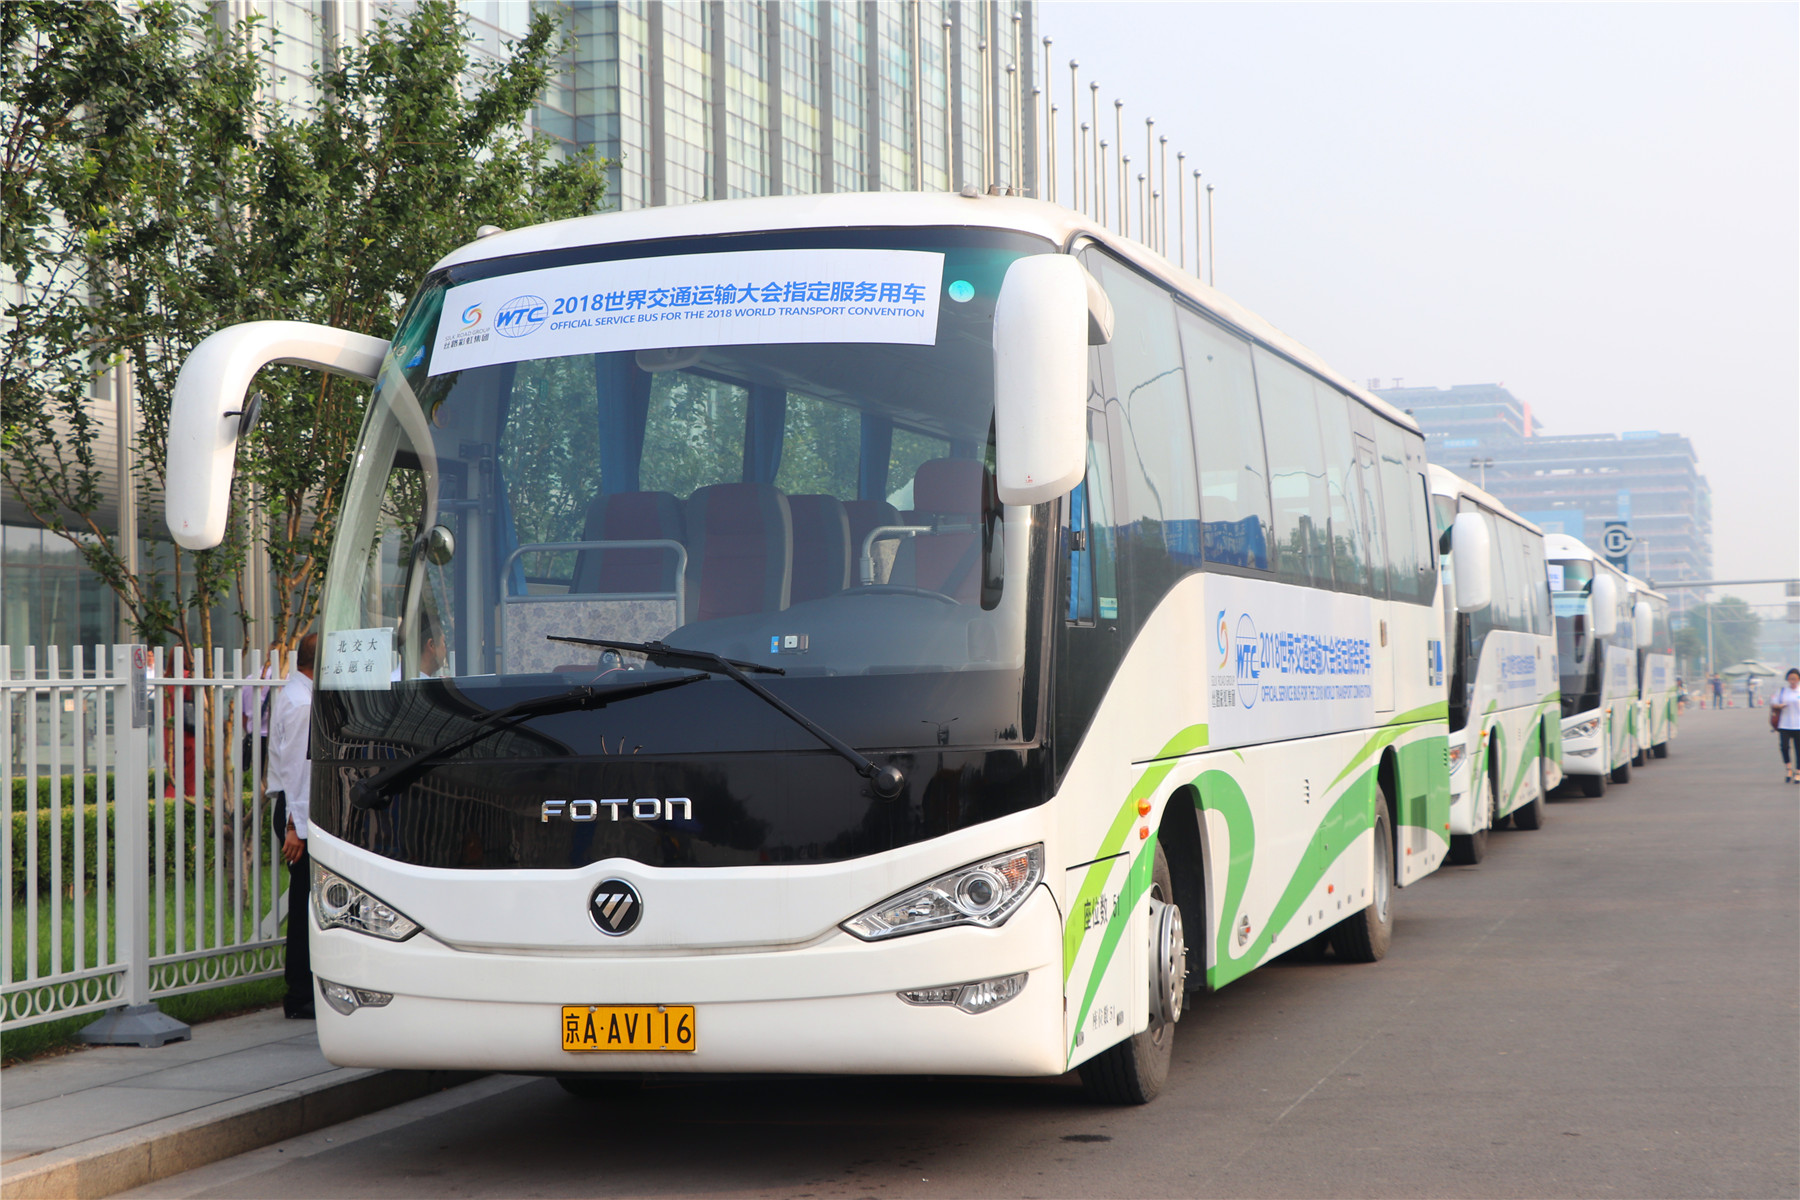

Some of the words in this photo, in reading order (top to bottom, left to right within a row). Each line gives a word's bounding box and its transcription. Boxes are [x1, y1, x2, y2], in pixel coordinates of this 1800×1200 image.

[552, 281, 926, 315] 2018世界交通运输大会指定服务用车
[497, 306, 543, 327] WTC
[550, 319, 593, 331] OFFICIAL
[595, 315, 635, 326] SERVICE
[638, 313, 658, 323] BUS
[660, 311, 682, 321] FOR
[684, 310, 704, 319] THE
[707, 309, 732, 318] 2018
[735, 307, 776, 317] WORLD
[779, 306, 845, 316] TRANSPORT
[848, 306, 925, 318] CONVENTION
[337, 638, 378, 653] 北交大
[1260, 631, 1371, 675] 2018世界交通运输大会指定服务用车
[333, 658, 375, 674] 志愿者
[1236, 644, 1260, 678] WTC
[541, 797, 692, 823] FOTON
[1084, 893, 1108, 931] 座位数
[1113, 894, 1120, 918] 51
[566, 1013, 692, 1044] 京A·AV116
